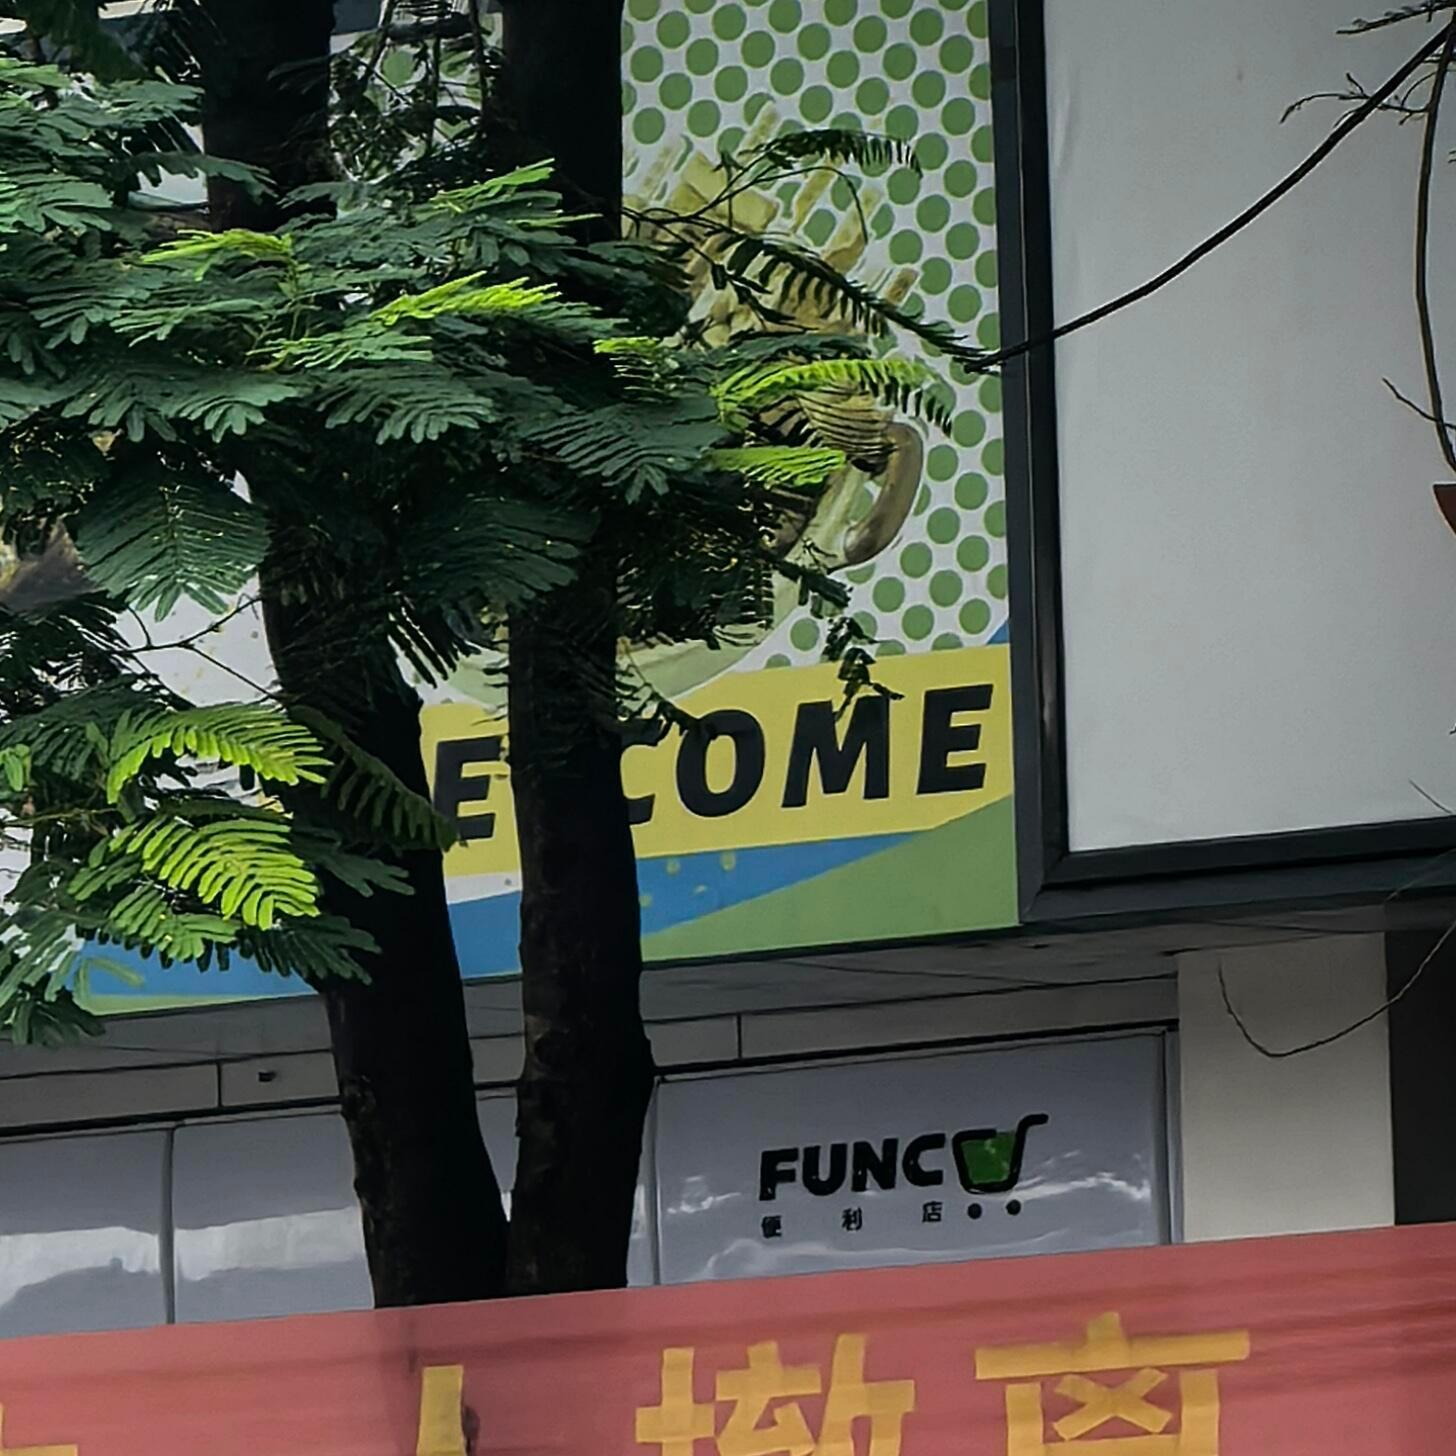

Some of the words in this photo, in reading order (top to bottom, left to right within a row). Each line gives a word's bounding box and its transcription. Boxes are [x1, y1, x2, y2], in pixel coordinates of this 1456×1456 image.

[759, 1132, 947, 1202] FUNC
[761, 1201, 943, 1239] 便利店
